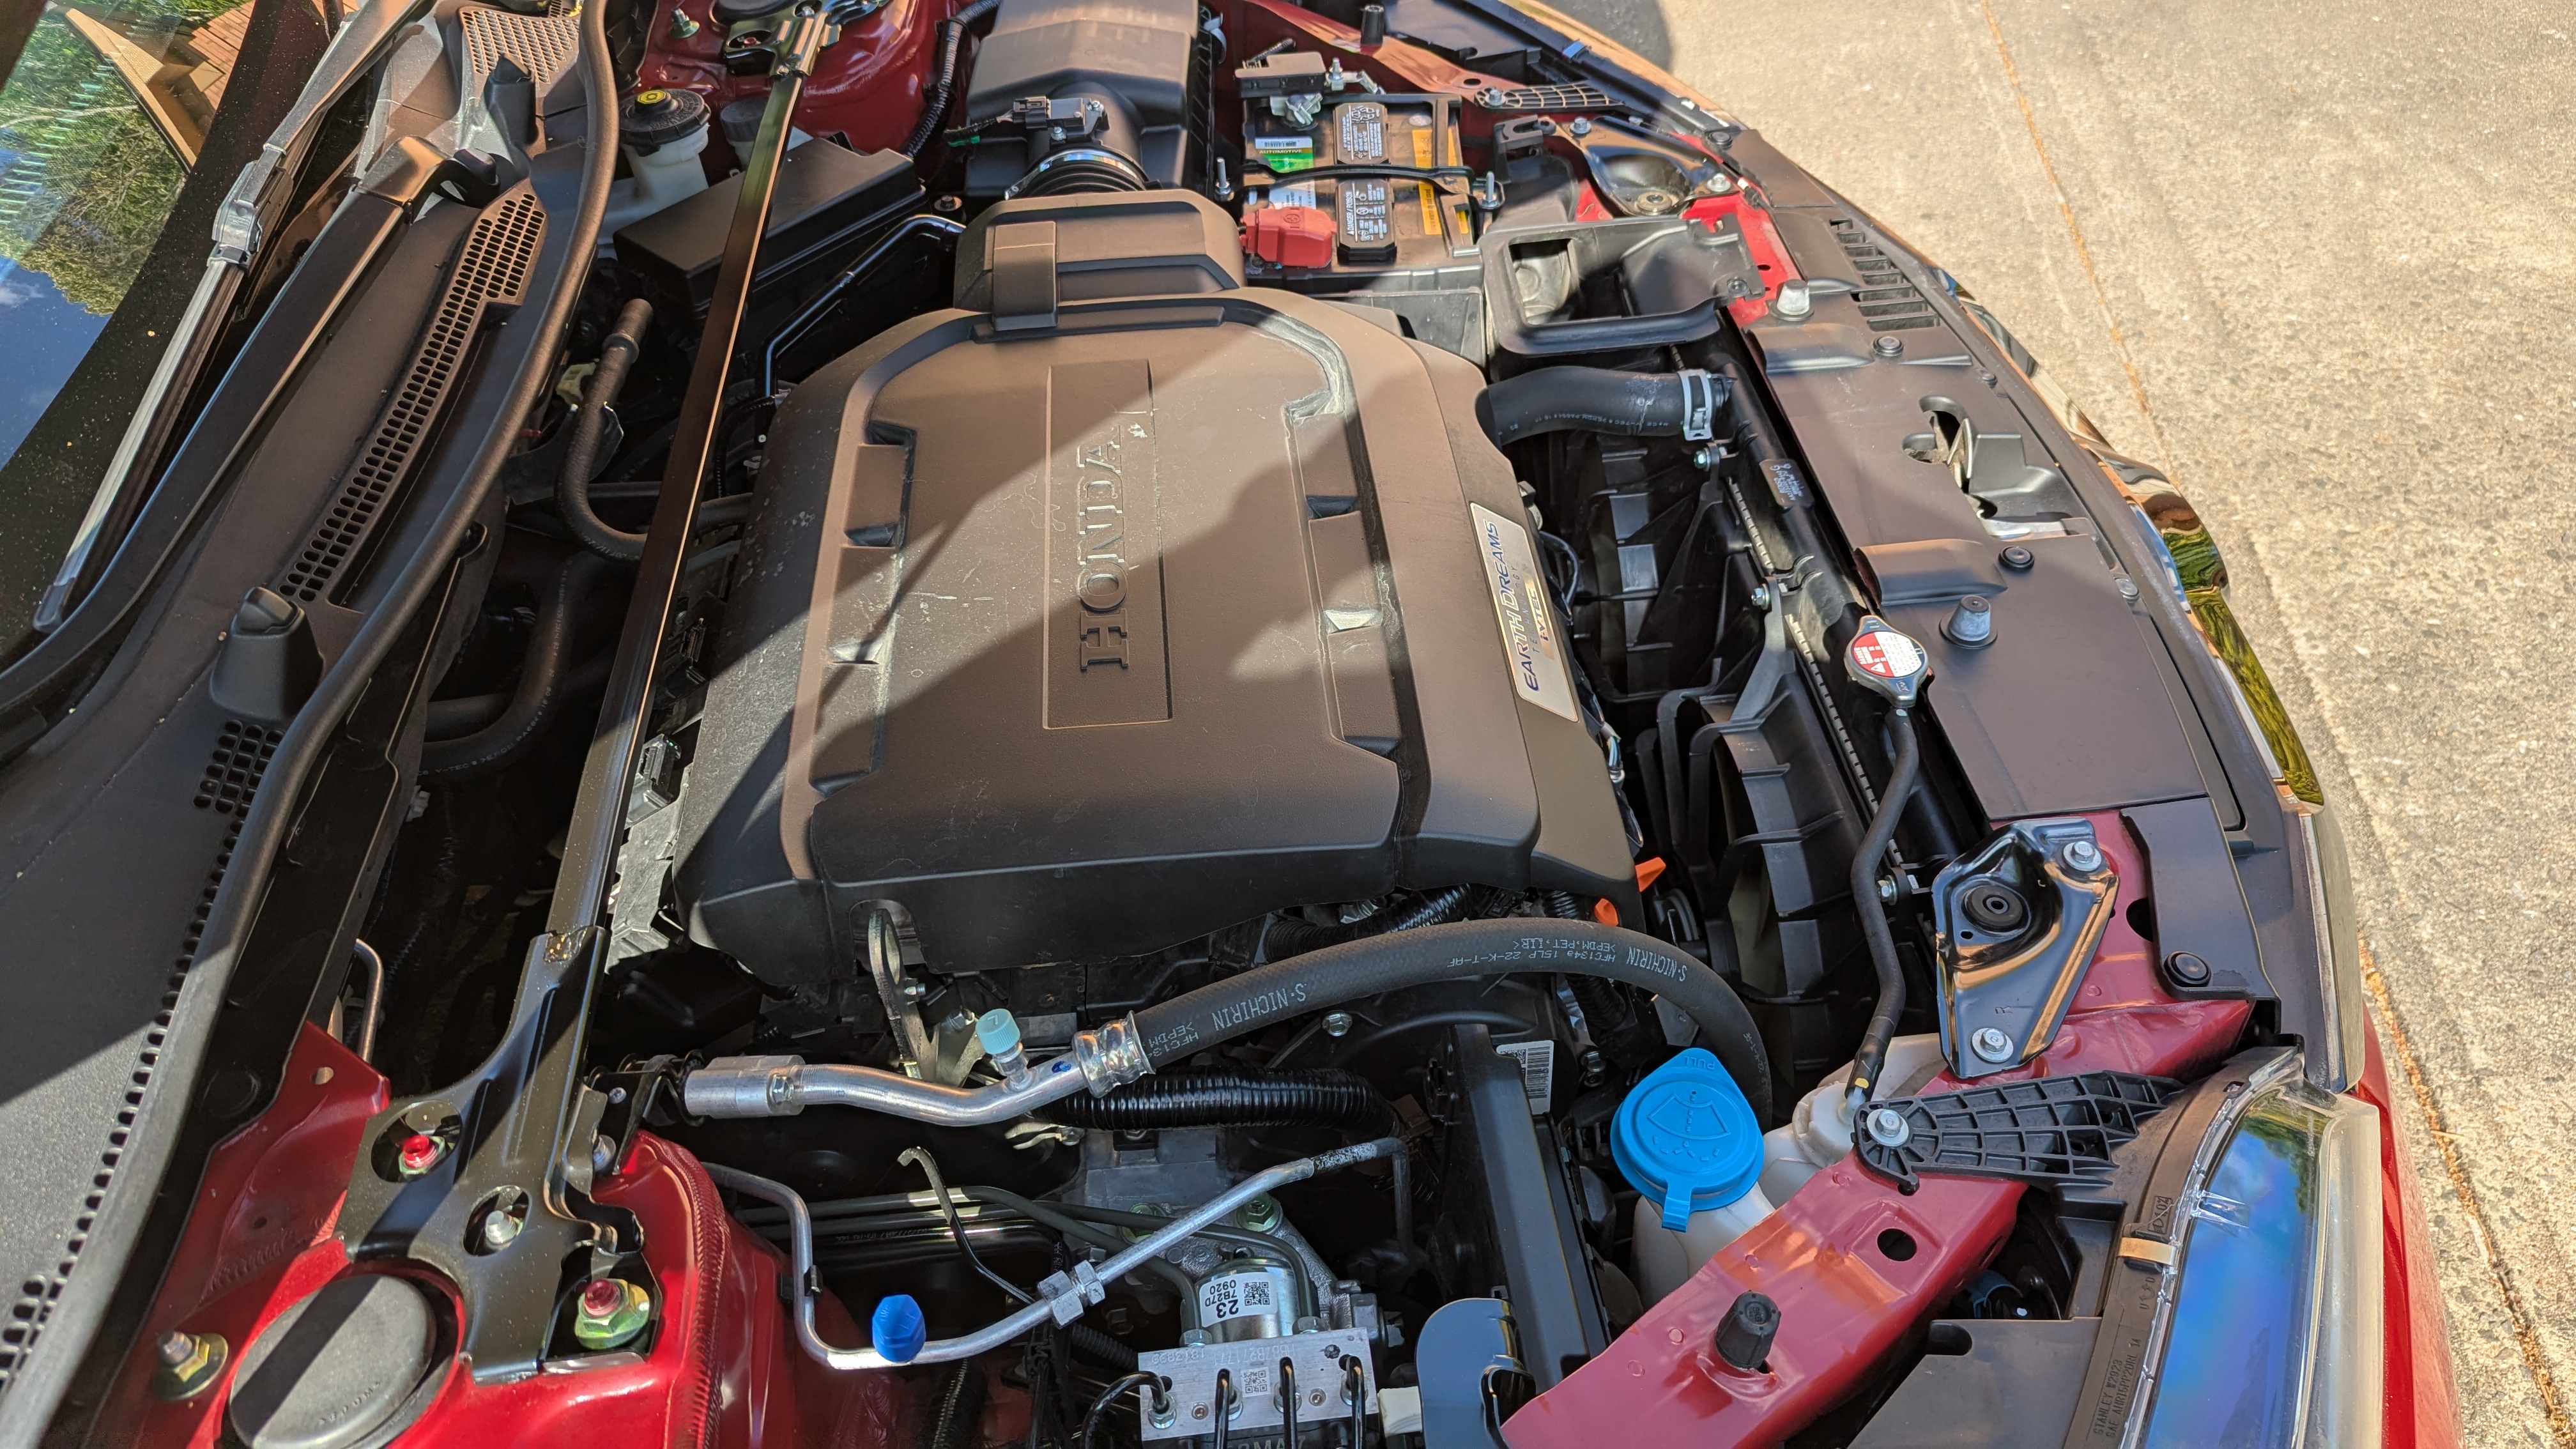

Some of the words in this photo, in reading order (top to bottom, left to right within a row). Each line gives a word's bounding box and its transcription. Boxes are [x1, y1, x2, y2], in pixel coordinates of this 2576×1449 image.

[1346, 212, 1354, 231] DANGER
[1077, 424, 1129, 671] HONDA
[1483, 519, 1518, 611] DREAMS
[1508, 612, 1540, 692] EARTH
[1683, 1055, 1715, 1071] PULL
[1209, 1278, 1237, 1295] 0920
[1204, 1287, 1238, 1308] 7B27D
[1216, 1298, 1239, 1319] 23
[2093, 1392, 2113, 1436] STANLEY
